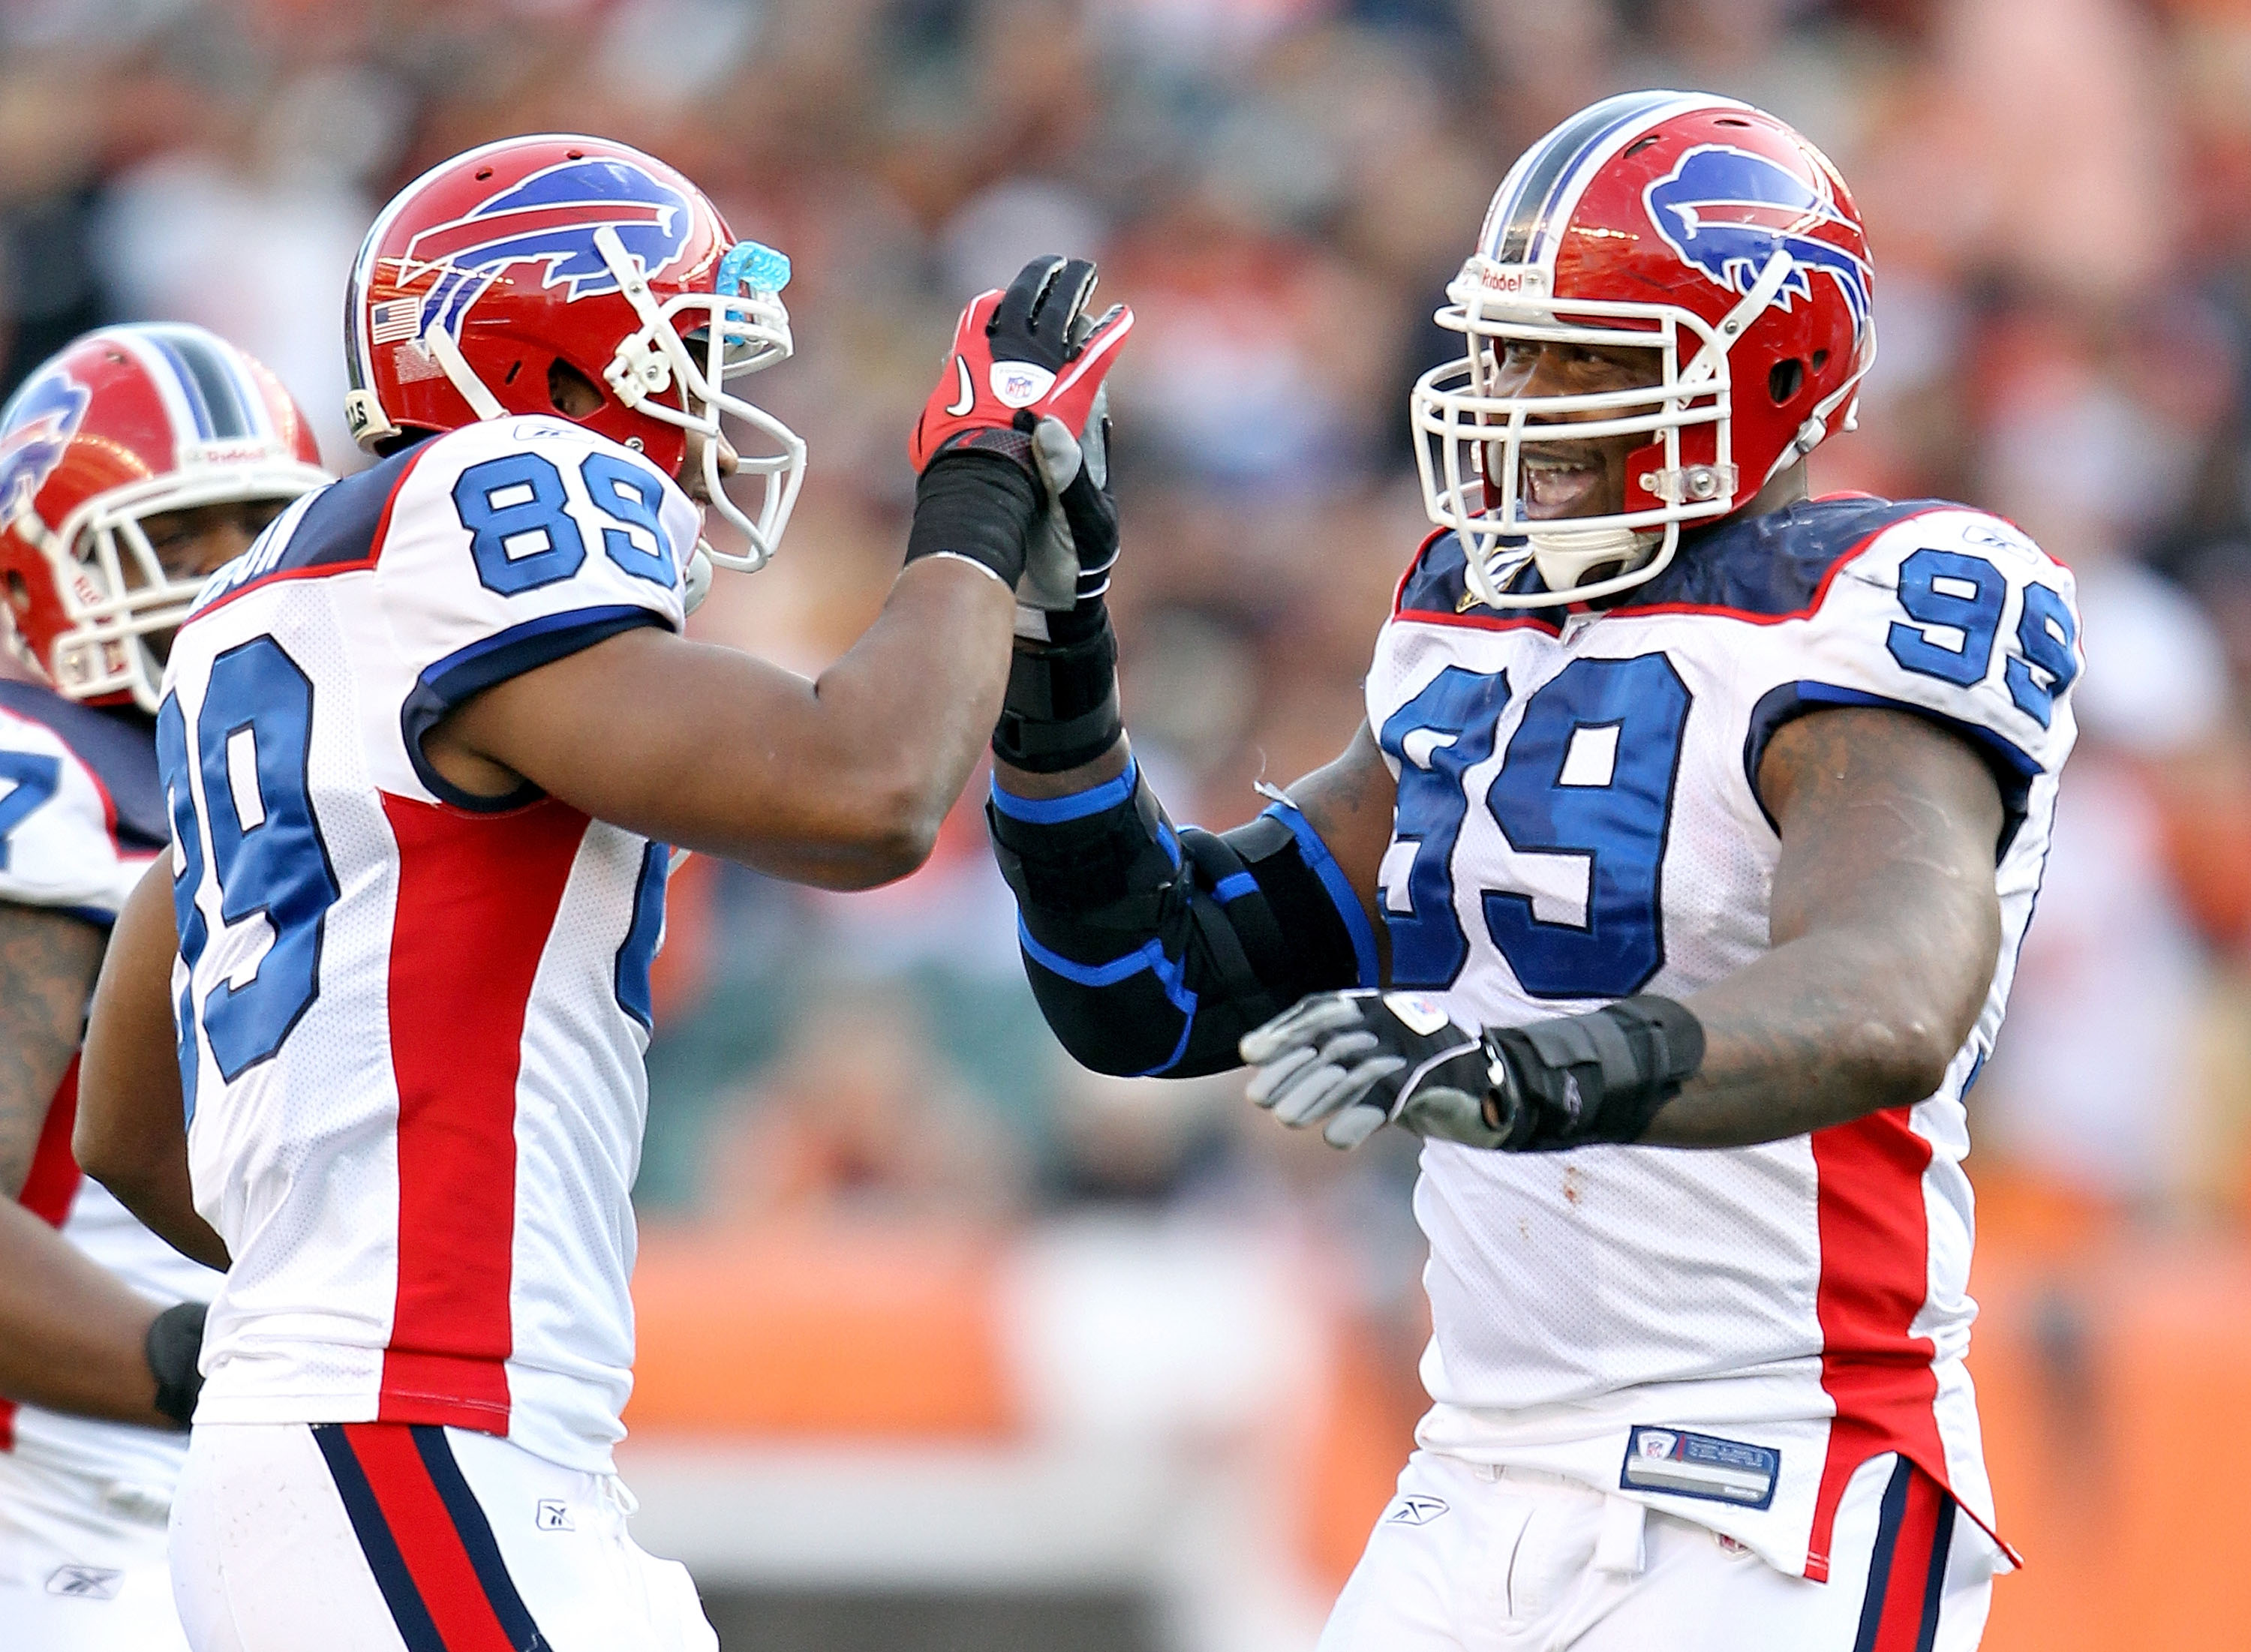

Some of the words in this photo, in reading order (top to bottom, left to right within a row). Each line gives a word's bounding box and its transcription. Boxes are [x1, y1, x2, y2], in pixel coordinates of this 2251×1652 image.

[451, 451, 677, 599] 89
[1886, 547, 2078, 732] 99
[1378, 650, 1694, 999] 99
